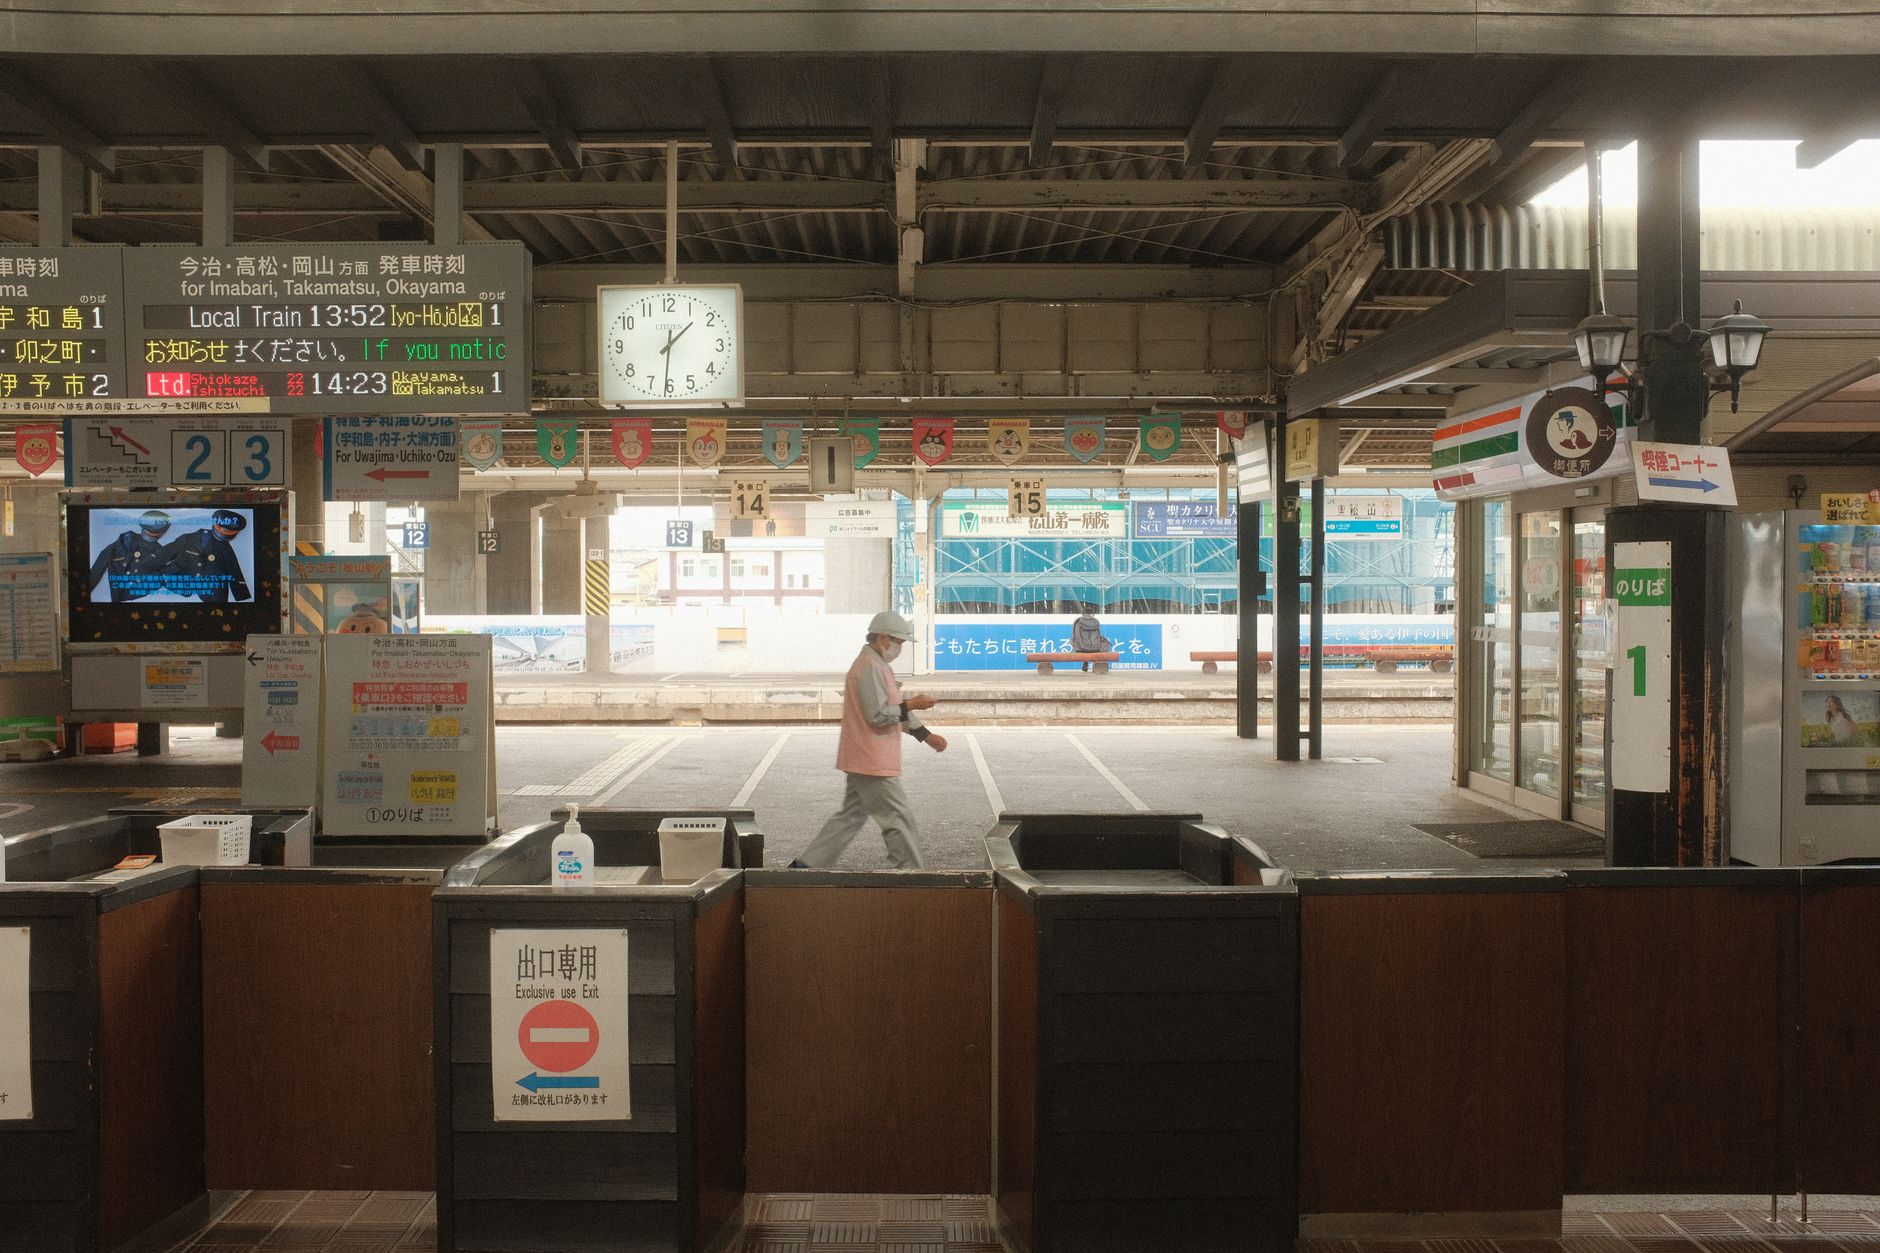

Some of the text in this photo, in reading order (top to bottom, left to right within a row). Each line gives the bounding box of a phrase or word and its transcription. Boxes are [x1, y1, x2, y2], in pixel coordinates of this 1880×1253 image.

[180, 255, 465, 277] 今治・高松・岡山 方面 発車時刻
[181, 279, 466, 299] for Imabari, Takamatsu, Okayama
[479, 291, 505, 300] のりば
[80, 295, 106, 303] のりば
[663, 298, 675, 312] 12
[92, 307, 103, 328] 1
[190, 306, 240, 328] Local
[252, 305, 302, 327] Train
[310, 305, 385, 327] 13:52
[490, 304, 501, 325] 1
[642, 303, 651, 317] 11
[622, 316, 634, 330] 10
[706, 312, 715, 327] 2
[145, 340, 229, 363] お知らせ
[364, 338, 506, 361] If you notic
[615, 339, 623, 353] 9
[715, 338, 724, 352] 3
[625, 363, 635, 377] 8
[706, 361, 715, 375] 4
[92, 375, 108, 396] 2
[147, 374, 190, 396] Ltd.
[190, 373, 304, 385] Shiokaze 22
[312, 373, 387, 394] 14:23
[491, 372, 502, 393] 1
[647, 376, 655, 390] 7
[666, 379, 674, 393] 6
[686, 375, 695, 389] 5
[190, 385, 304, 397] Ishizuchi 22
[414, 383, 484, 395] Takamatsu
[185, 435, 211, 480] 2
[244, 435, 271, 481] 3
[336, 451, 351, 462] For
[1642, 448, 1718, 474] 喫煙コーナー
[1553, 459, 1591, 472] 御便所
[736, 482, 764, 491] 乗車口
[1014, 481, 1041, 490] 乗車口
[736, 494, 765, 515] 14
[1013, 493, 1042, 514] 15
[1029, 511, 1109, 530] 松山第一病院
[1140, 524, 1161, 532] SCU
[407, 530, 424, 545] 12
[669, 529, 688, 544] 13
[482, 539, 497, 551] 12
[1616, 577, 1666, 597] のりば
[1627, 645, 1647, 697] 1
[517, 944, 597, 981] 出口専用
[516, 984, 599, 999] Exclusive use Exit
[511, 1094, 608, 1106] 左側に改札口があります
